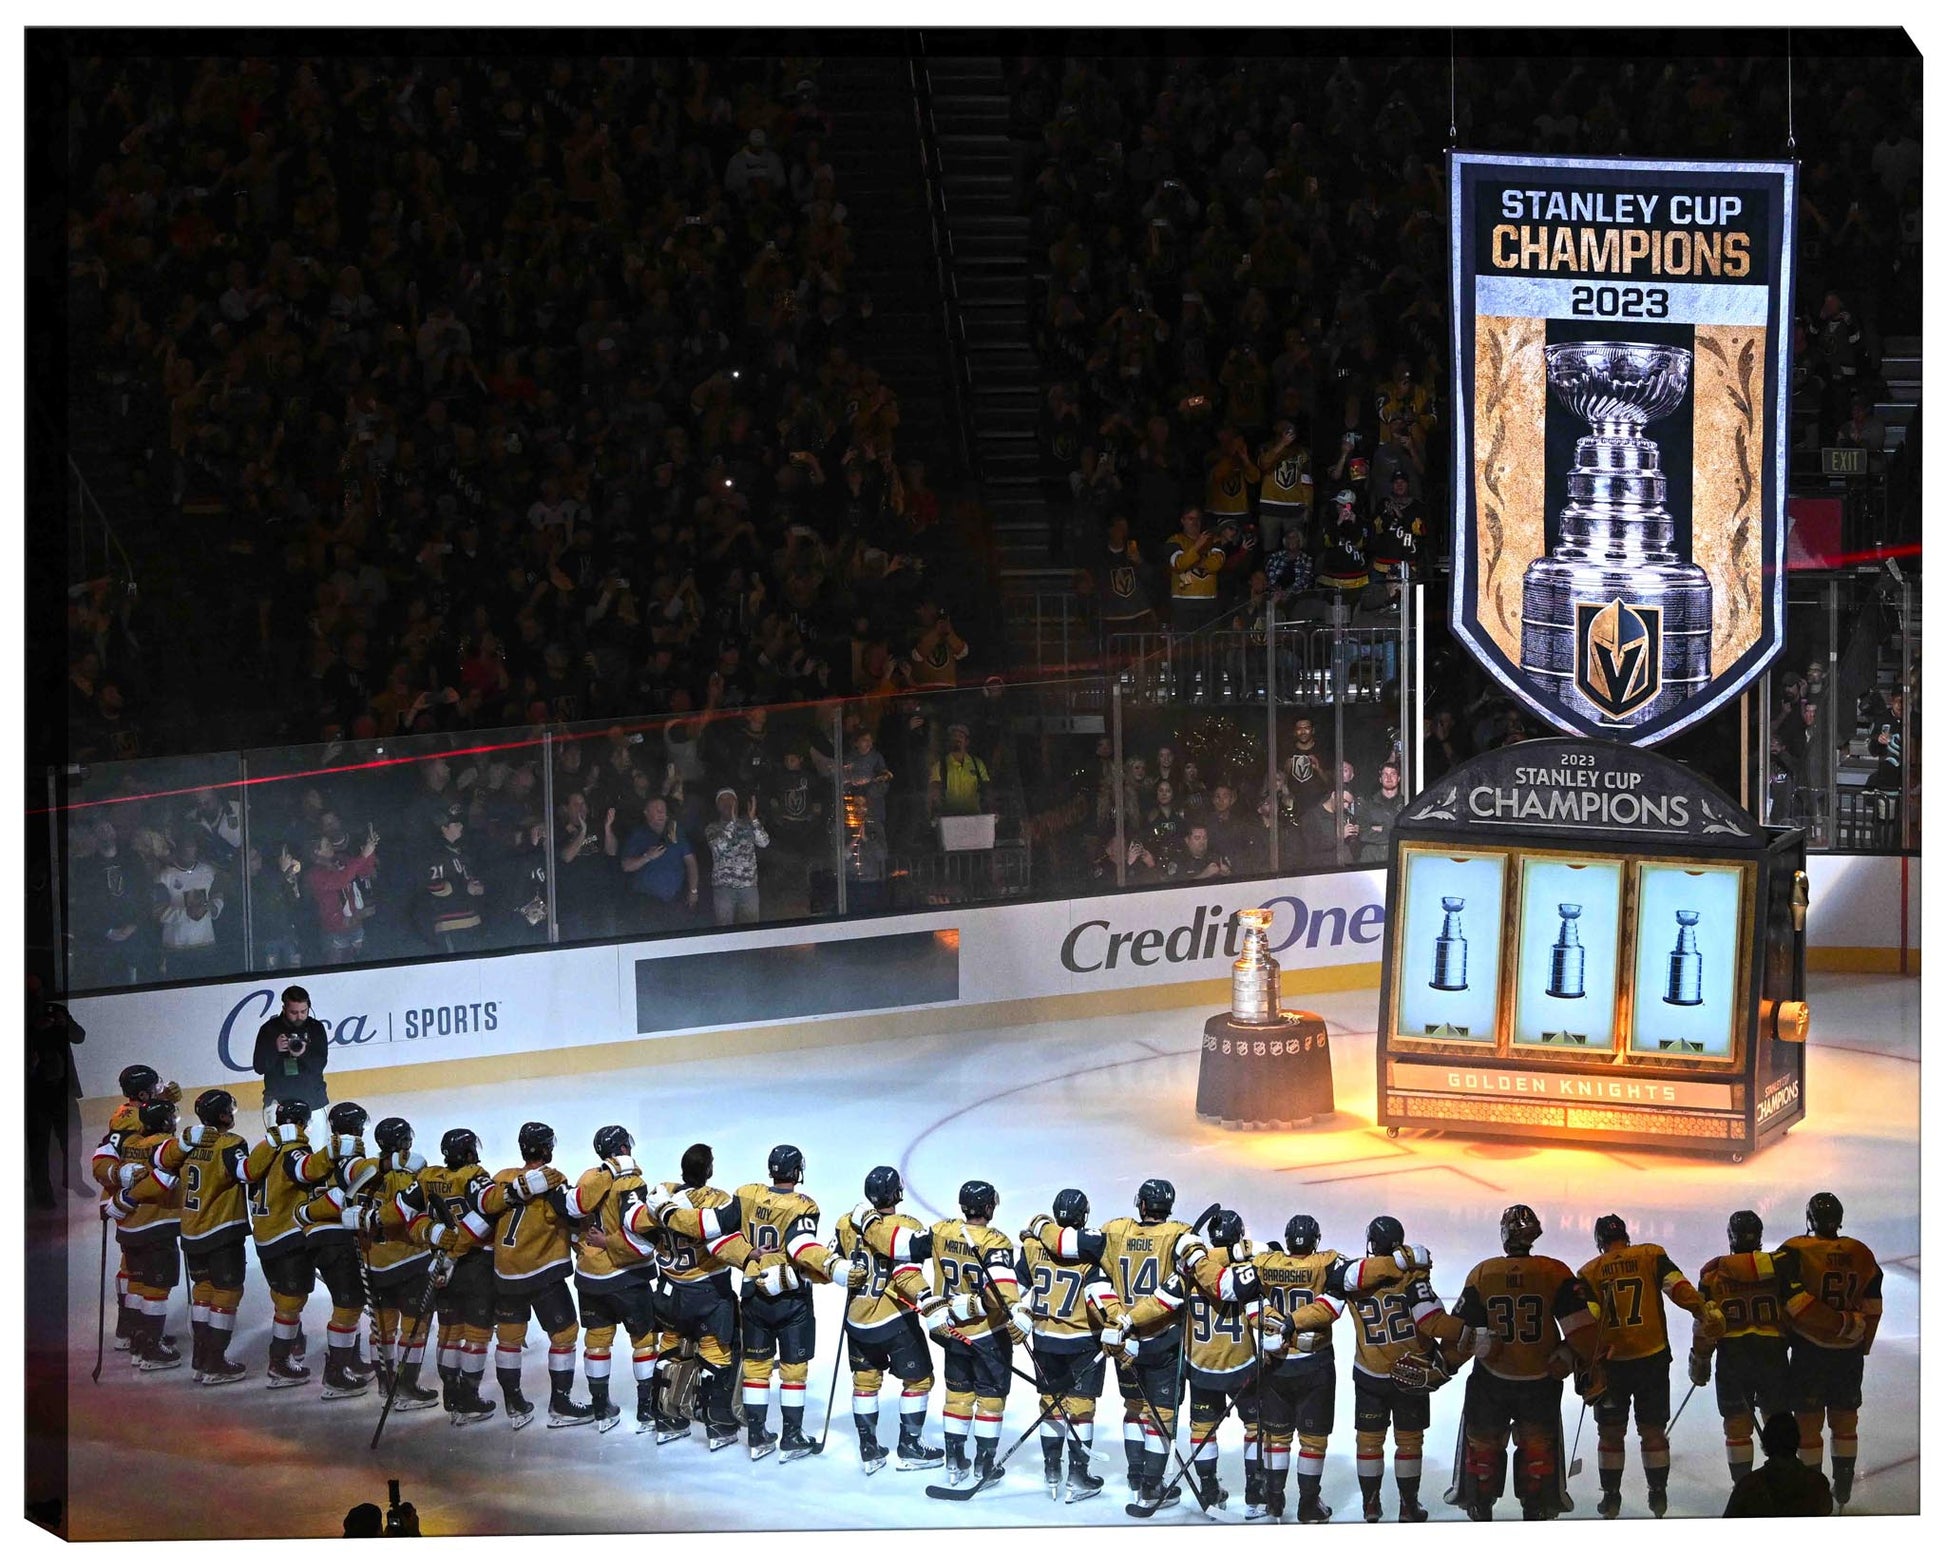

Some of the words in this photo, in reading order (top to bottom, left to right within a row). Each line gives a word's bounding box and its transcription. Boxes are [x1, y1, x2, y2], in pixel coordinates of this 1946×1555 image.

[1501, 189, 1659, 224] STANLEY
[1669, 196, 1742, 226] CUP
[1492, 224, 1751, 278] CHAMPIONS
[1572, 286, 1669, 318] 2023
[1831, 451, 1860, 472] EXIT
[1515, 767, 1600, 788] STANLEY
[1604, 770, 1642, 790] CUP
[1561, 754, 1595, 767] 2023
[1469, 786, 1690, 828] CHAMPIONS
[217, 989, 377, 1072] Cca
[405, 1001, 498, 1039] SPORTS
[1448, 1073, 1546, 1093] GOLDEN
[1560, 1080, 1676, 1101] KNIGHTS
[1757, 1080, 1799, 1122] CHAMPIONS
[755, 1205, 773, 1220] ROY
[796, 1216, 816, 1232] 10
[1126, 1237, 1154, 1252] HAGUE
[1033, 1265, 1083, 1319] 27
[1118, 1256, 1159, 1307] 14
[1262, 1266, 1313, 1284] BARBASHEV
[1188, 1292, 1245, 1345] 94
[1356, 1294, 1418, 1346] 22
[1487, 1294, 1544, 1345] 33
